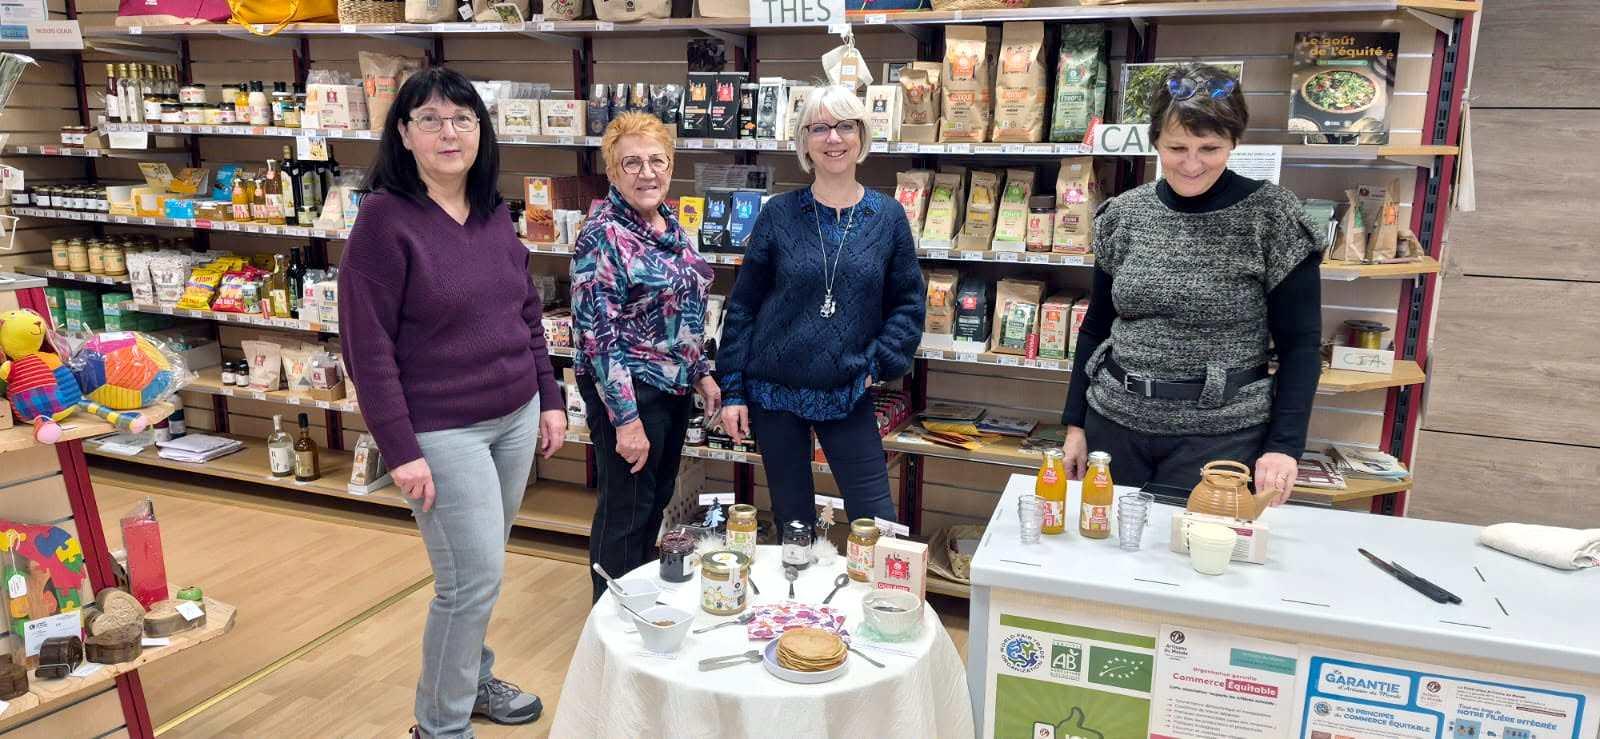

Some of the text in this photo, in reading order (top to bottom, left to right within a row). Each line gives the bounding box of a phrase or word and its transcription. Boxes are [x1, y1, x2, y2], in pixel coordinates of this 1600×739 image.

[1303, 35, 1355, 48] Le goût
[1311, 47, 1327, 56] de
[1331, 46, 1384, 58] l'équité
[1001, 654, 1043, 673] ORGANIZATION
[1052, 653, 1077, 670] AB
[1173, 672, 1225, 687] Commerce
[1325, 673, 1401, 694] GARANTIE
[1344, 713, 1387, 726] COMMERCE
[1355, 708, 1394, 720] PRINCIPES
[1457, 708, 1483, 719] NOTRE
